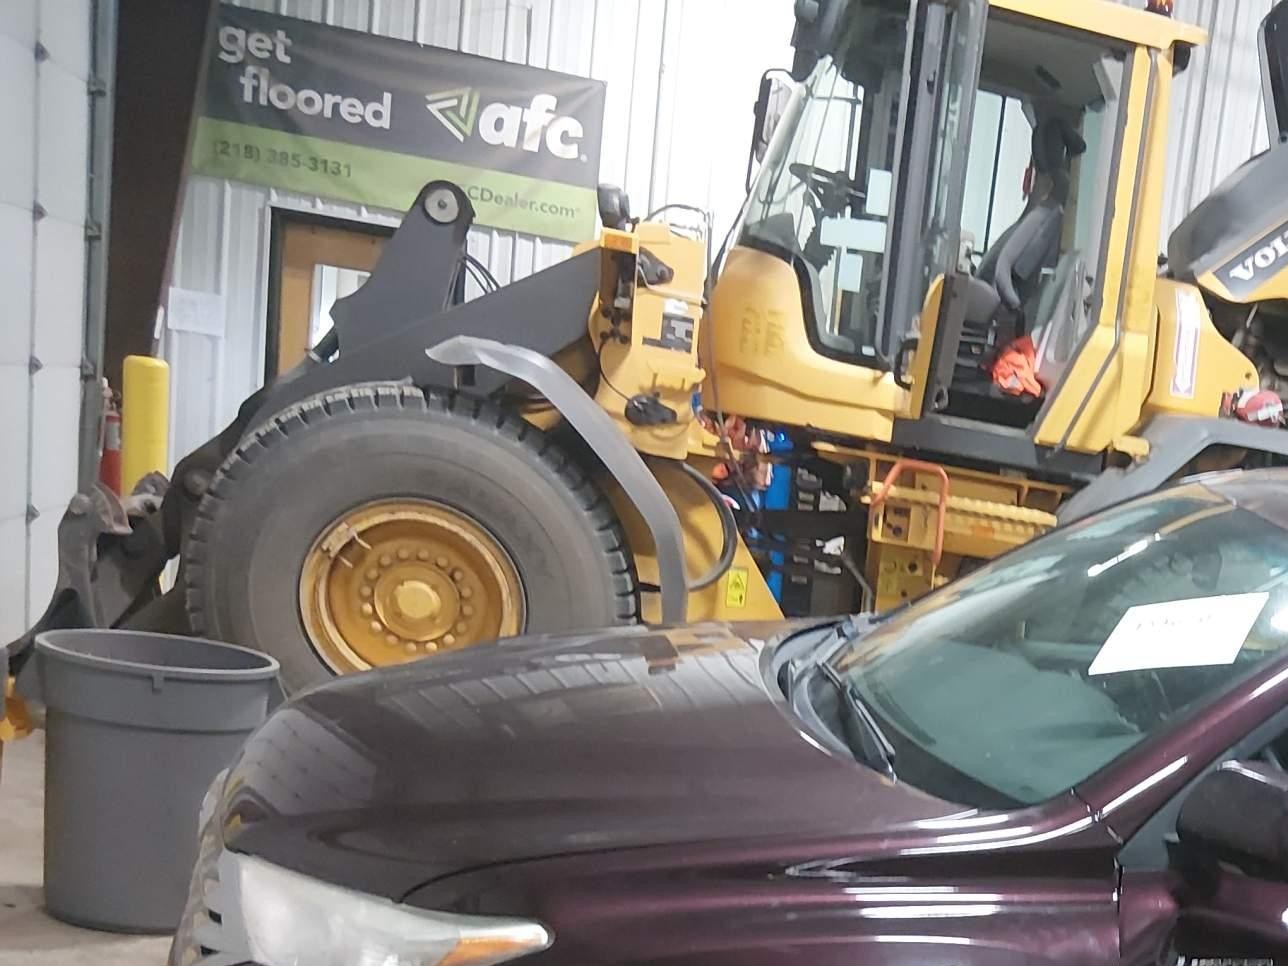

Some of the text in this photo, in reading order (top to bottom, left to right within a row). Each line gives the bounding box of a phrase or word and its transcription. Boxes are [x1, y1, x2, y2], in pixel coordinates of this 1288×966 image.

[218, 26, 292, 64] get
[239, 65, 392, 129] floored
[214, 140, 260, 163] (218)
[463, 183, 576, 218] CDealer.com
